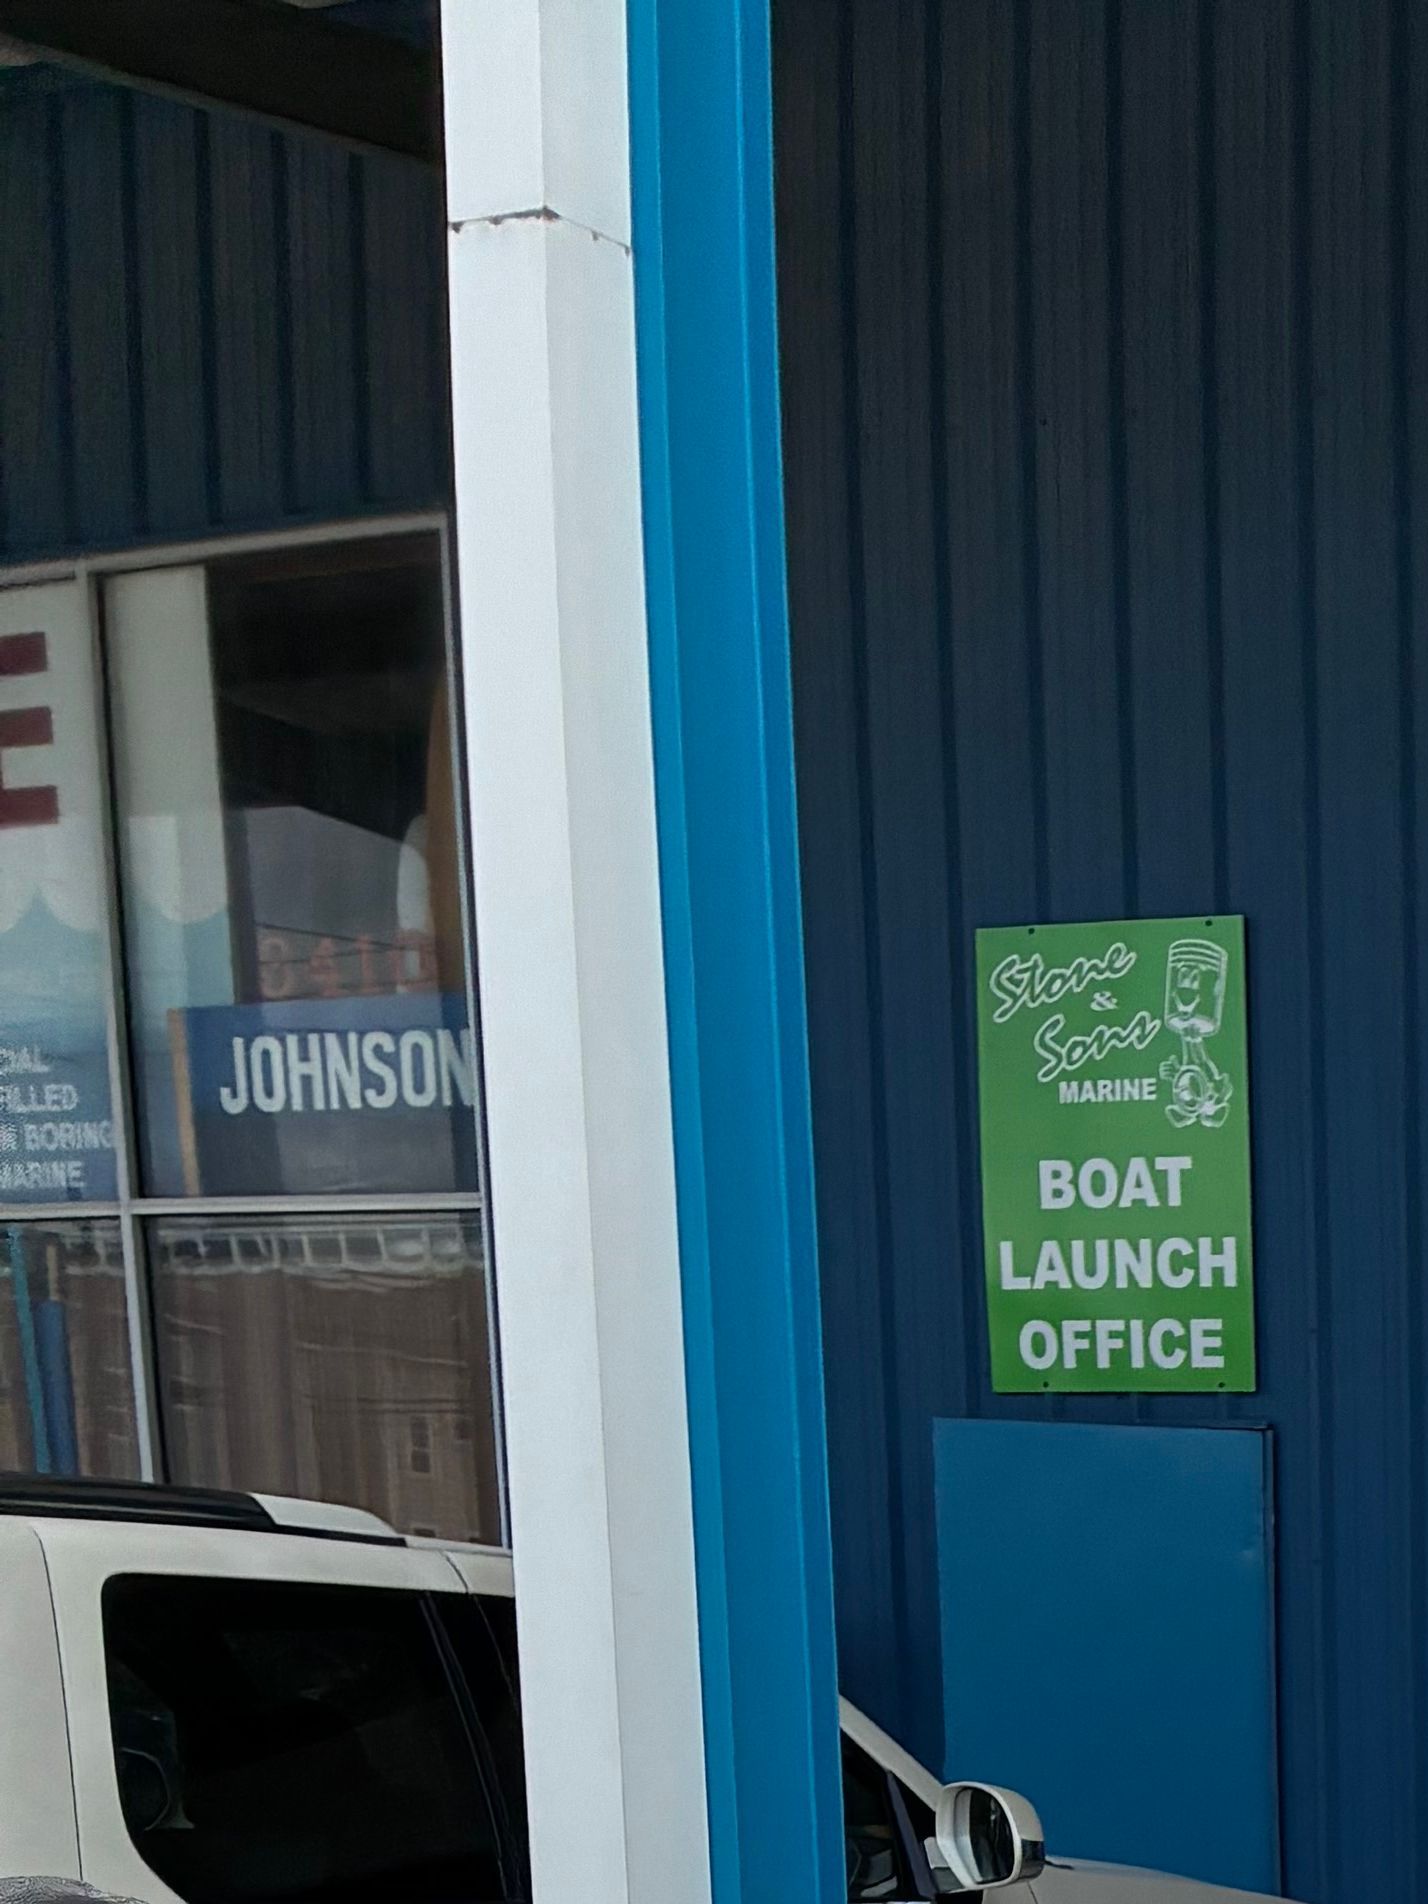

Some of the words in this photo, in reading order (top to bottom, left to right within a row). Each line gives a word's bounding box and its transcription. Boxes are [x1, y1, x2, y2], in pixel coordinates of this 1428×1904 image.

[990, 942, 1137, 1023] Stone
[1090, 991, 1118, 1011] &
[219, 1027, 479, 1115] JOHNSON
[1034, 1011, 1162, 1082] Sons
[1059, 1078, 1157, 1104] MARINE
[1038, 1156, 1193, 1210] BOAT
[999, 1236, 1238, 1291] LAUNCH
[1018, 1317, 1225, 1370] OFFICE
